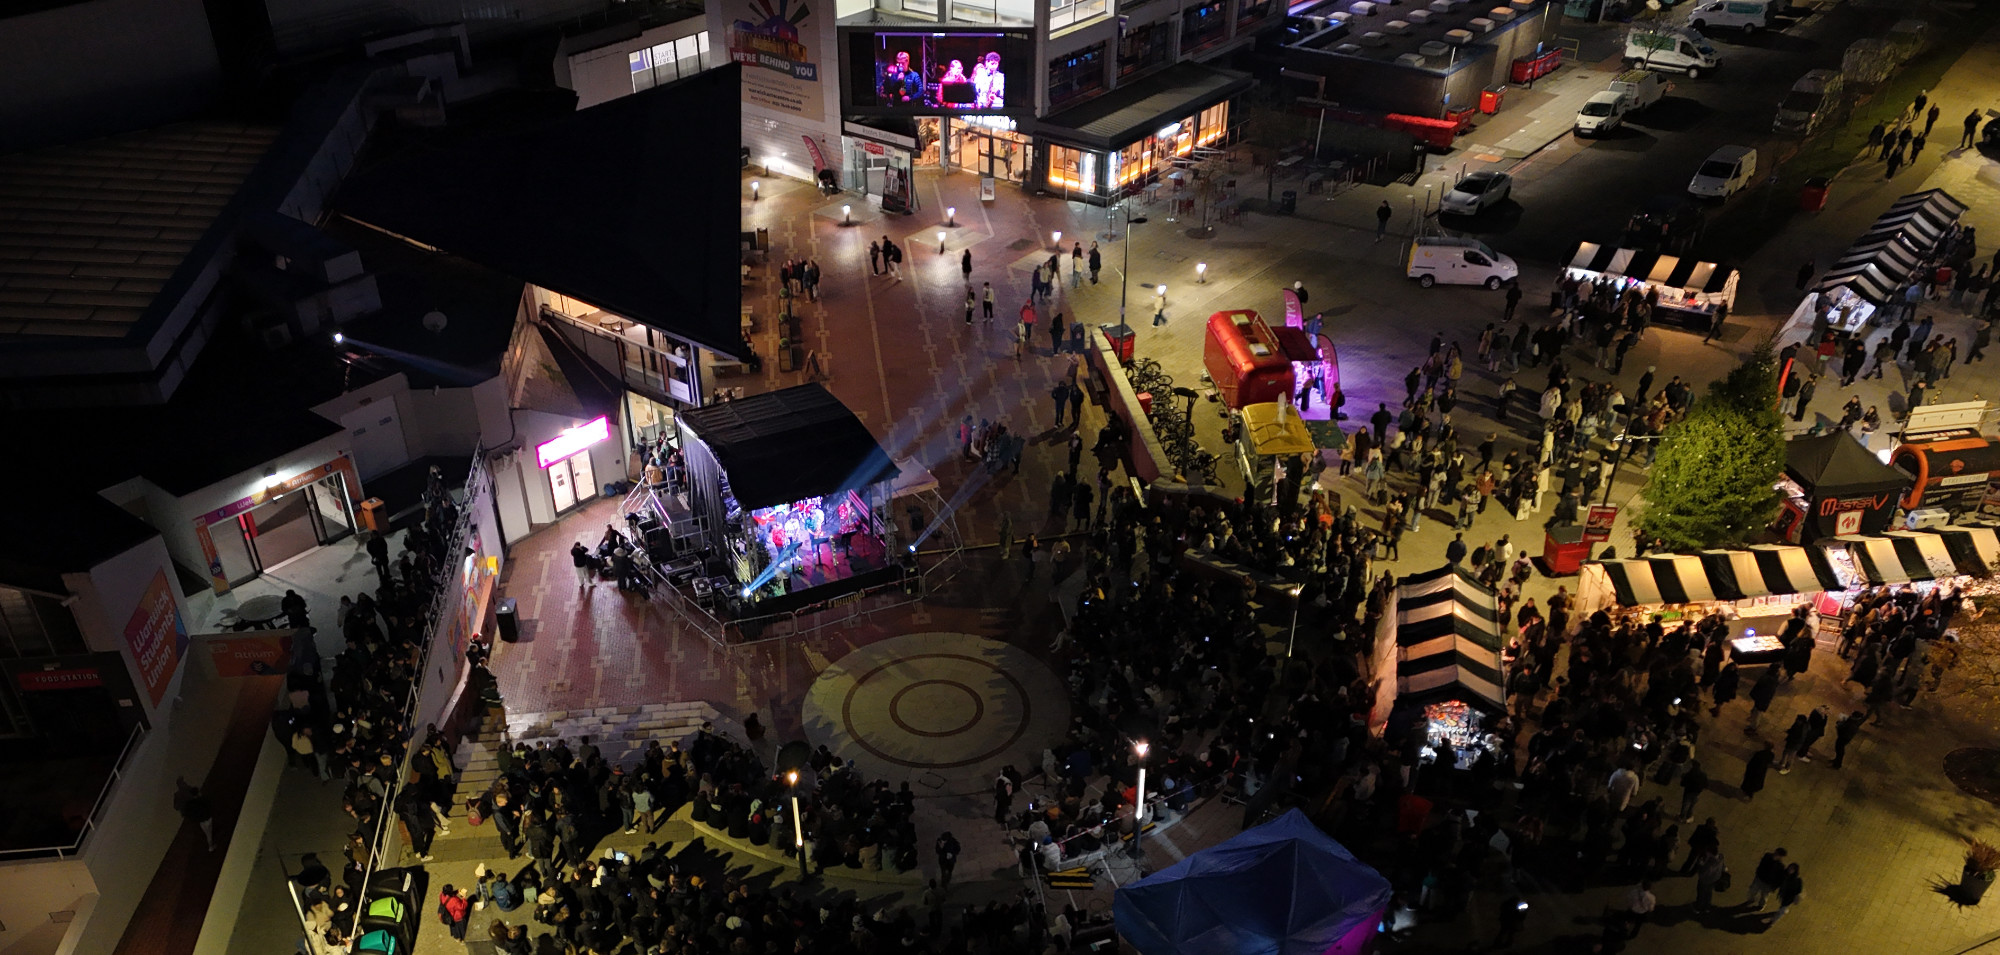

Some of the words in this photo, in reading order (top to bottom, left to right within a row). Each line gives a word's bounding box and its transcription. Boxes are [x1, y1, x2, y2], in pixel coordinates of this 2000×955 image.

[732, 51, 757, 63] WE'RE
[760, 54, 791, 70] BEHIND
[795, 65, 814, 77] YOU
[854, 140, 864, 150] sky
[865, 143, 883, 154] sports
[237, 494, 266, 509] Welcome
[291, 473, 315, 487] Atrium
[133, 590, 169, 653] Warwick
[147, 644, 172, 688] Union
